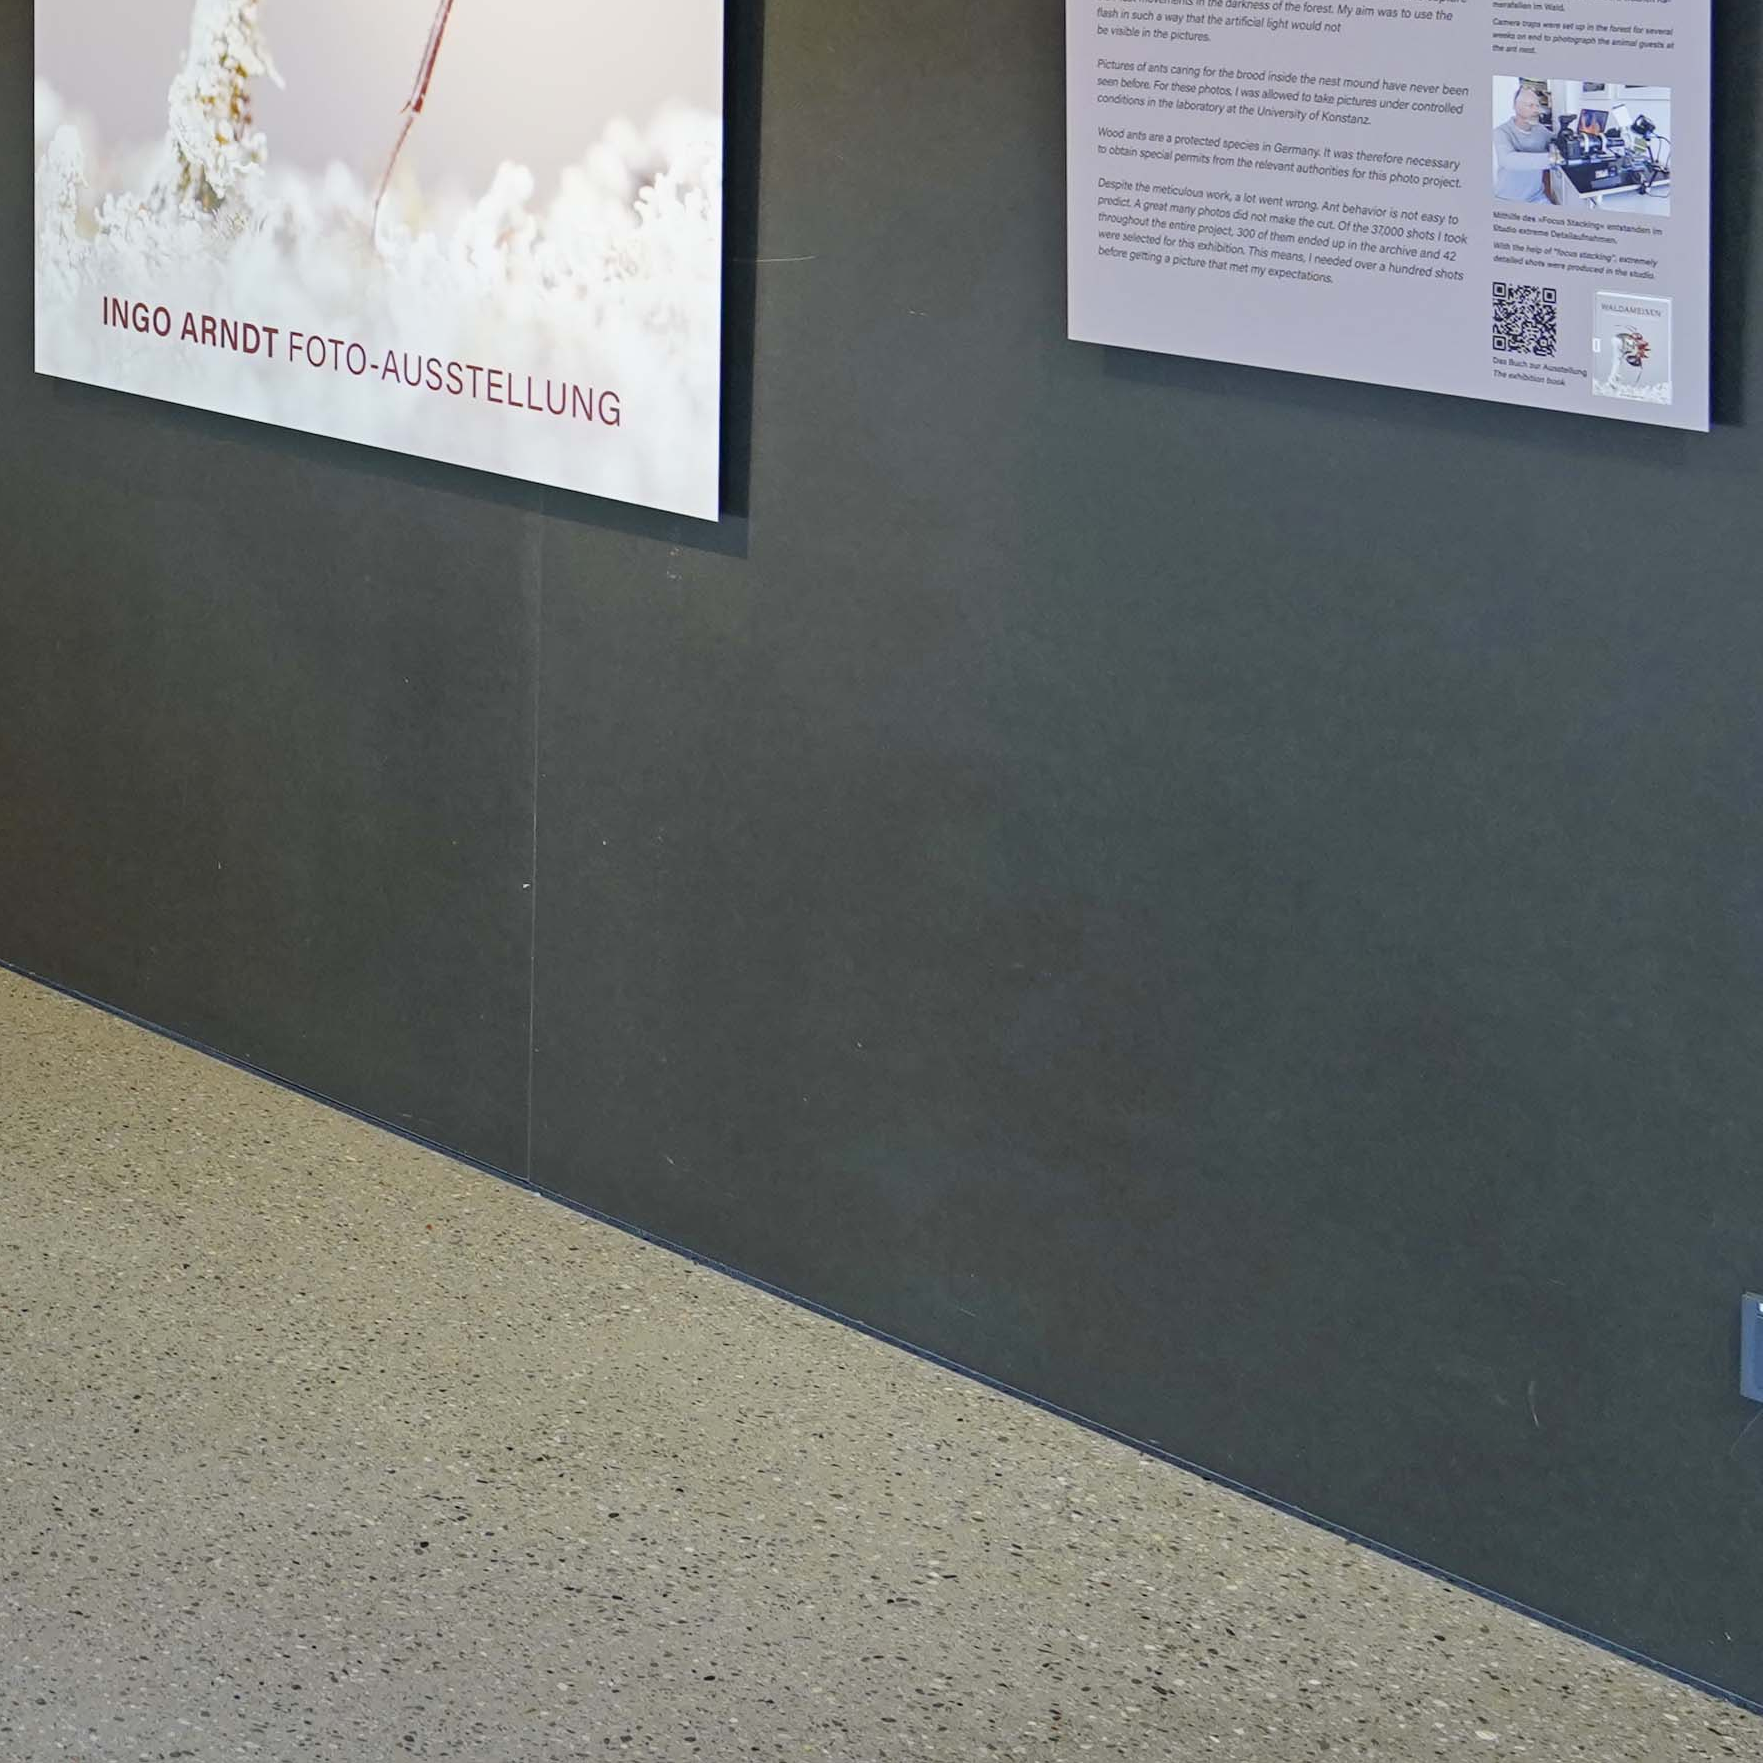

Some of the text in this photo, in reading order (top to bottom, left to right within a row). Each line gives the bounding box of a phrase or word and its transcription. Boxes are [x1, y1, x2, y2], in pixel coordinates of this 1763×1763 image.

[1096, 142, 1107, 153] to
[1108, 144, 1138, 156] obtain
[1138, 148, 1173, 160] special
[1173, 152, 1211, 163] permits
[1211, 153, 1235, 166] from
[1236, 155, 1253, 168] the
[1254, 158, 1295, 172] relevant
[1295, 162, 1350, 177] authorities
[1350, 166, 1366, 179] for
[1367, 168, 1388, 181] this
[1388, 171, 1420, 184] photo
[1097, 126, 1125, 139] Wood
[1125, 130, 1147, 141] ants
[1148, 133, 1164, 142] are
[1165, 134, 1172, 143] a
[1173, 134, 1221, 148] protected
[1222, 139, 1259, 151] species
[1261, 141, 1272, 153] in
[1322, 147, 1331, 158] It
[1332, 150, 1355, 160] was
[1355, 150, 1403, 165] therefore
[1404, 156, 1460, 172] necessary
[102, 295, 622, 427] INGO ARNDT FOTO-AUSSTELLUNG
